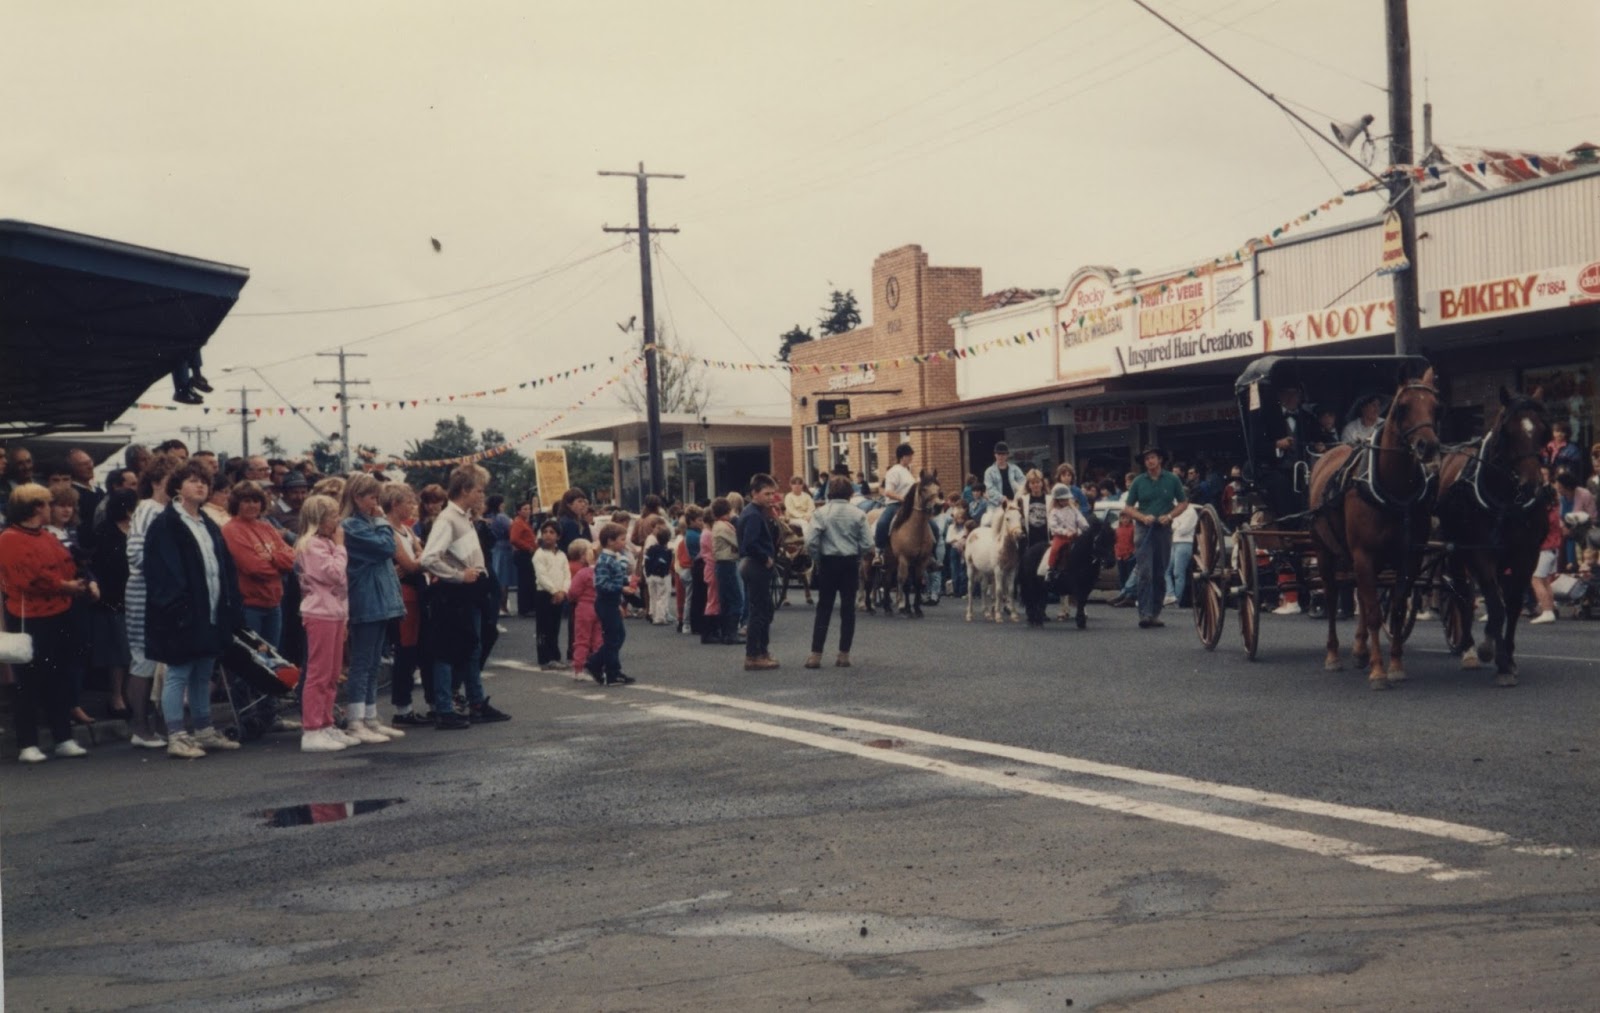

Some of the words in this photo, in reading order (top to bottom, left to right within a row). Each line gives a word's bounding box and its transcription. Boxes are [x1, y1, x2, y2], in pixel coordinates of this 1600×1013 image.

[1077, 288, 1105, 308] Rocky
[1177, 282, 1203, 301] VEGIE
[1440, 274, 1538, 319] BAKERY
[1128, 342, 1172, 368] Inspired
[1174, 336, 1199, 359] Hair
[1199, 329, 1253, 354] Creations
